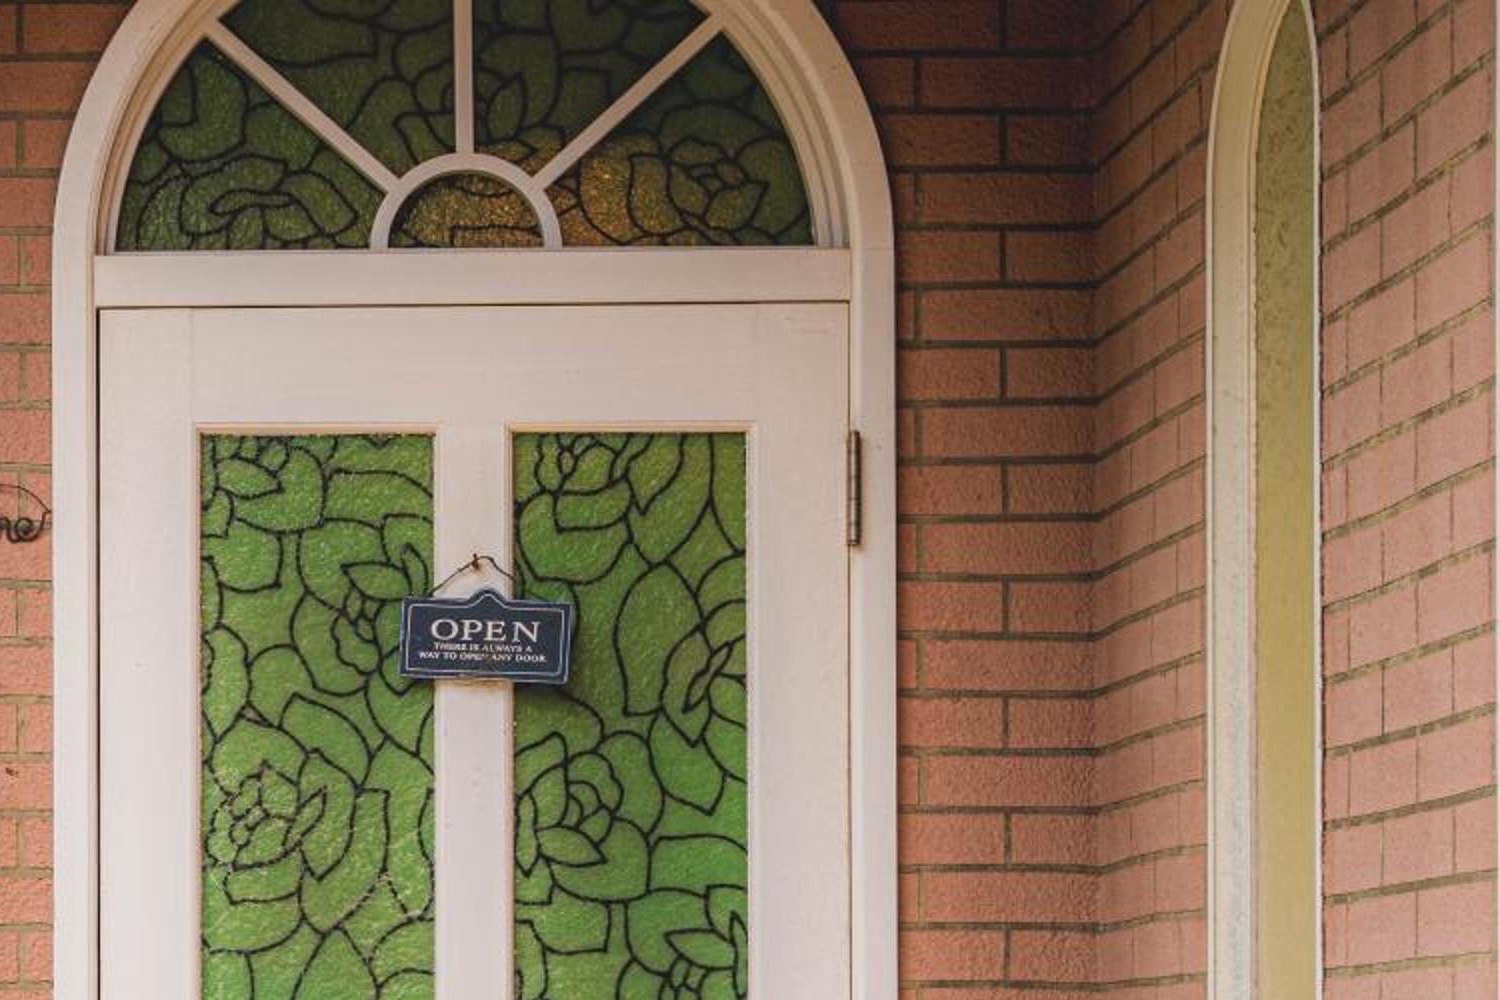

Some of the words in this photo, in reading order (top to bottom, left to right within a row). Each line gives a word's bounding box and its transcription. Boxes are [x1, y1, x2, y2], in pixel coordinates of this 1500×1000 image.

[429, 618, 541, 643] OPEN
[469, 643, 480, 652] IS
[481, 644, 523, 653] ALWAYS
[524, 645, 534, 653] A
[419, 651, 441, 660] WAY
[442, 652, 458, 661] TO
